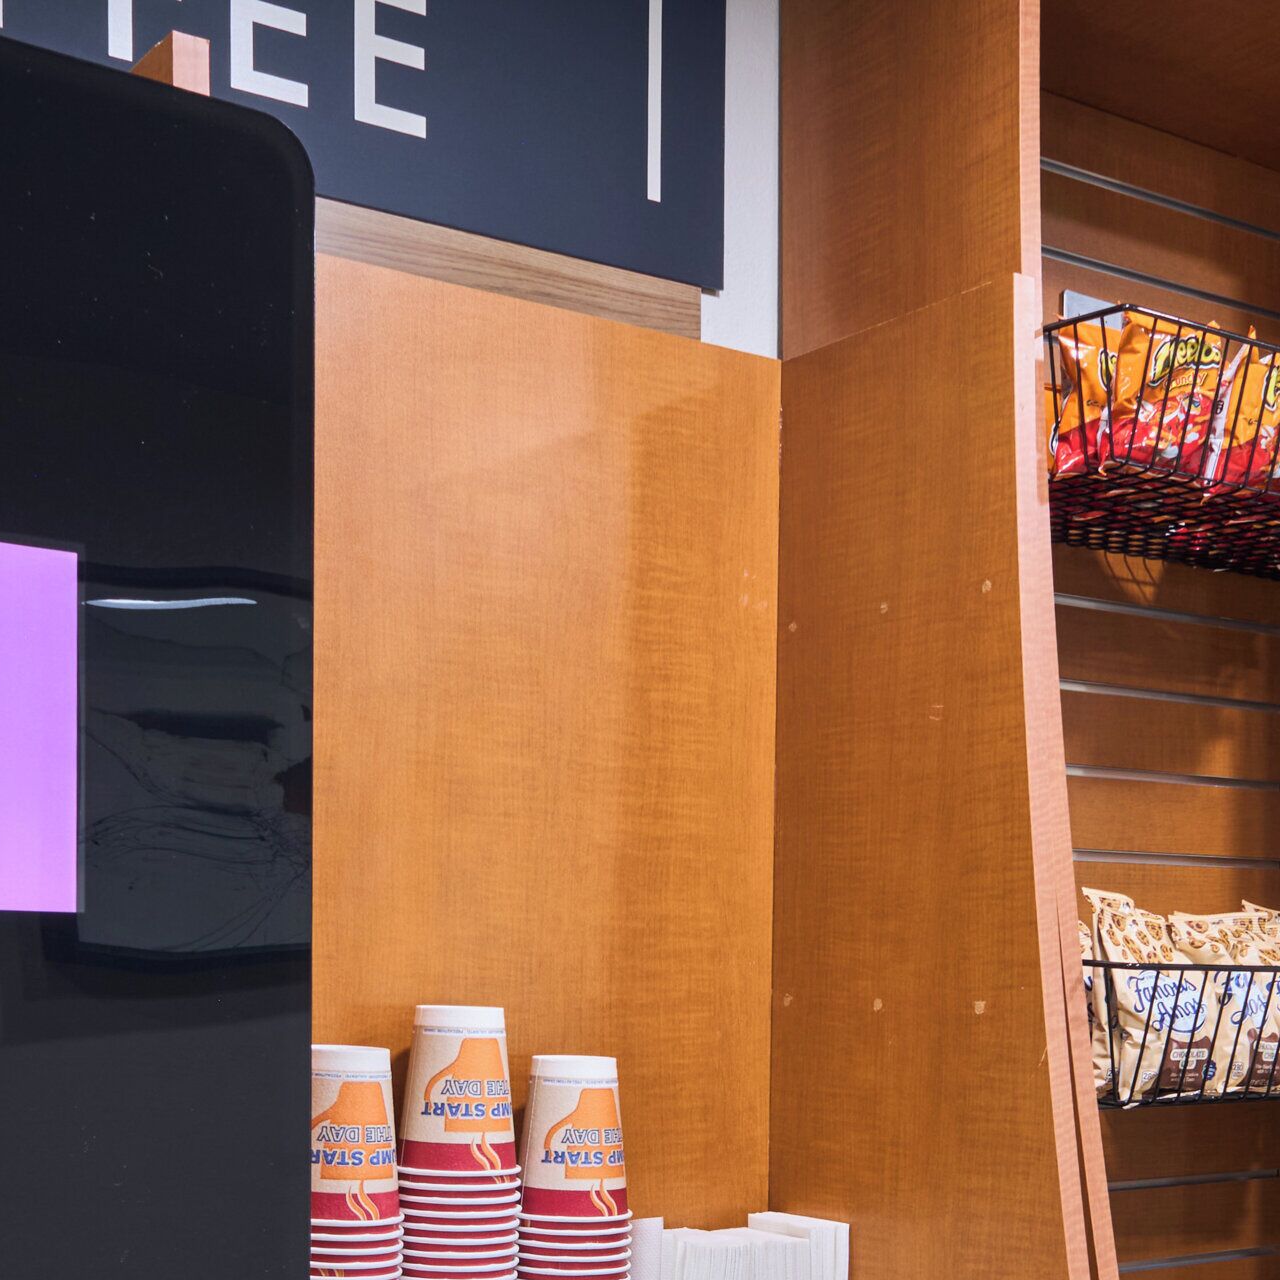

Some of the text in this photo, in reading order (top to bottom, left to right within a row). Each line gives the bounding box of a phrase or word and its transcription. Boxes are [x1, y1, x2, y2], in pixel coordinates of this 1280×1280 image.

[441, 1079, 482, 1096] DAY
[421, 1101, 486, 1118] START
[317, 1125, 360, 1142] DAY
[561, 1129, 600, 1144] DAY
[542, 1150, 603, 1165] START
